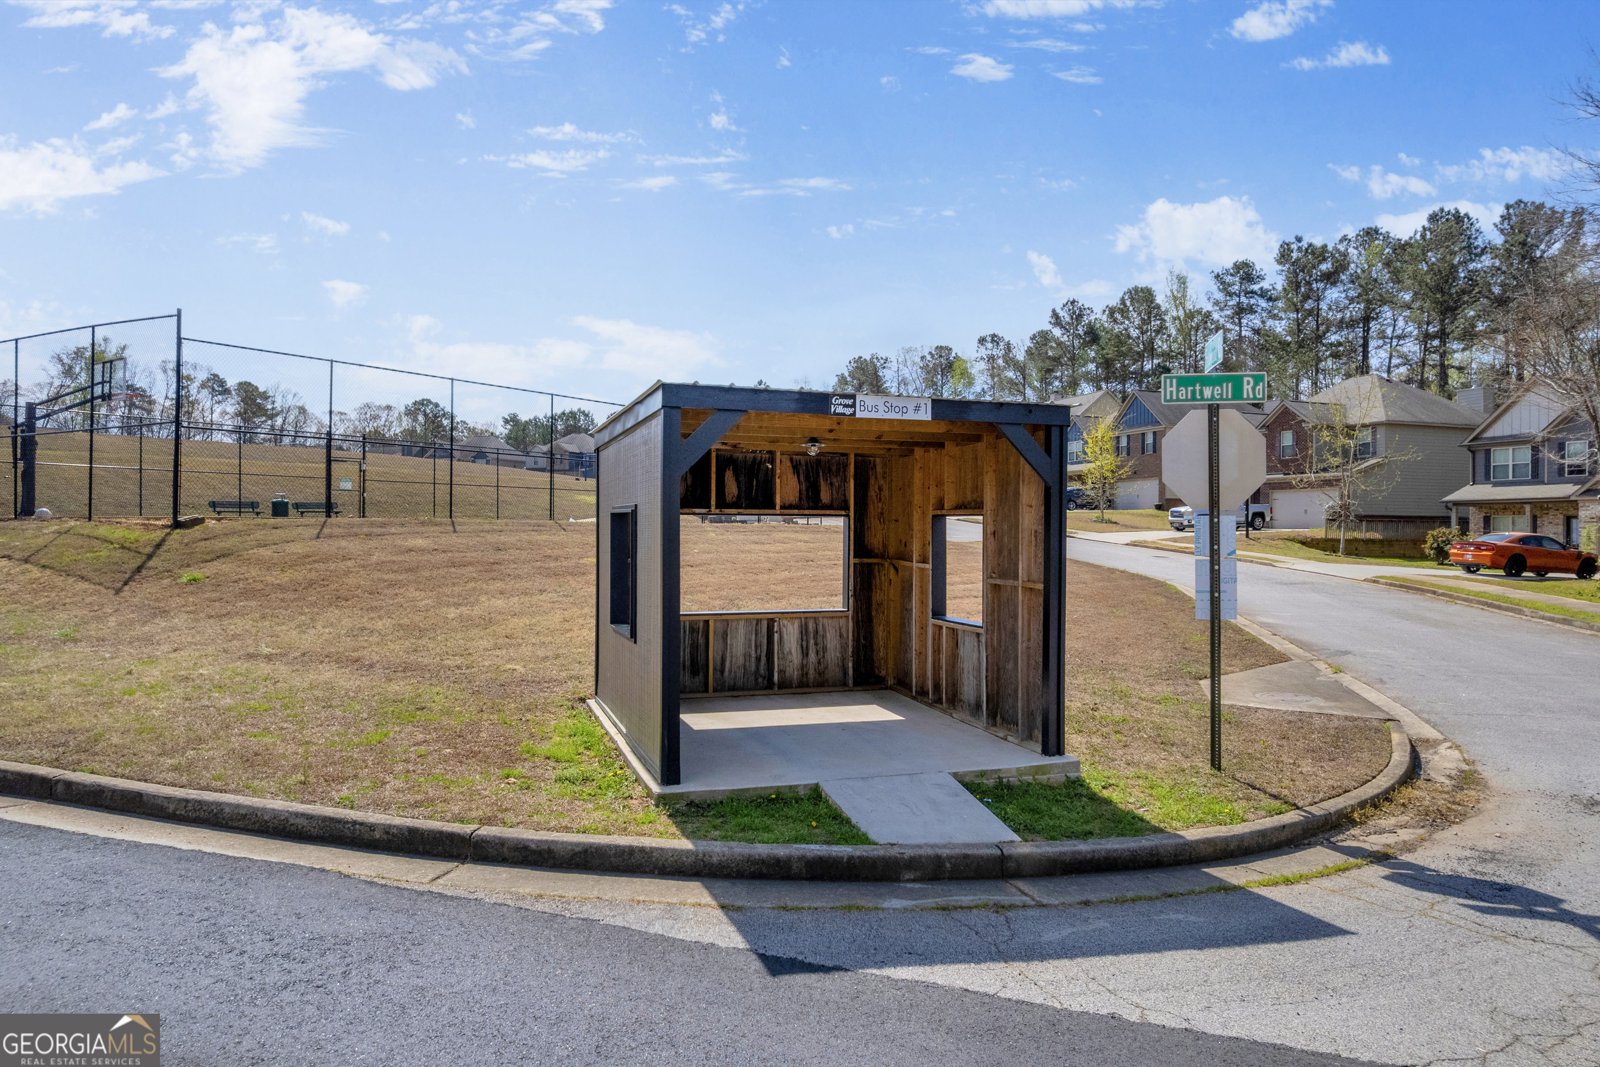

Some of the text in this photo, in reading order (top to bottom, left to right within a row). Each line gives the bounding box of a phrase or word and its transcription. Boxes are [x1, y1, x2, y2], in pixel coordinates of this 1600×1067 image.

[1166, 377, 1264, 400] Hartwell Rd
[832, 396, 854, 405] Grove
[831, 405, 855, 415] Village
[859, 400, 928, 416] Bus Stop #1
